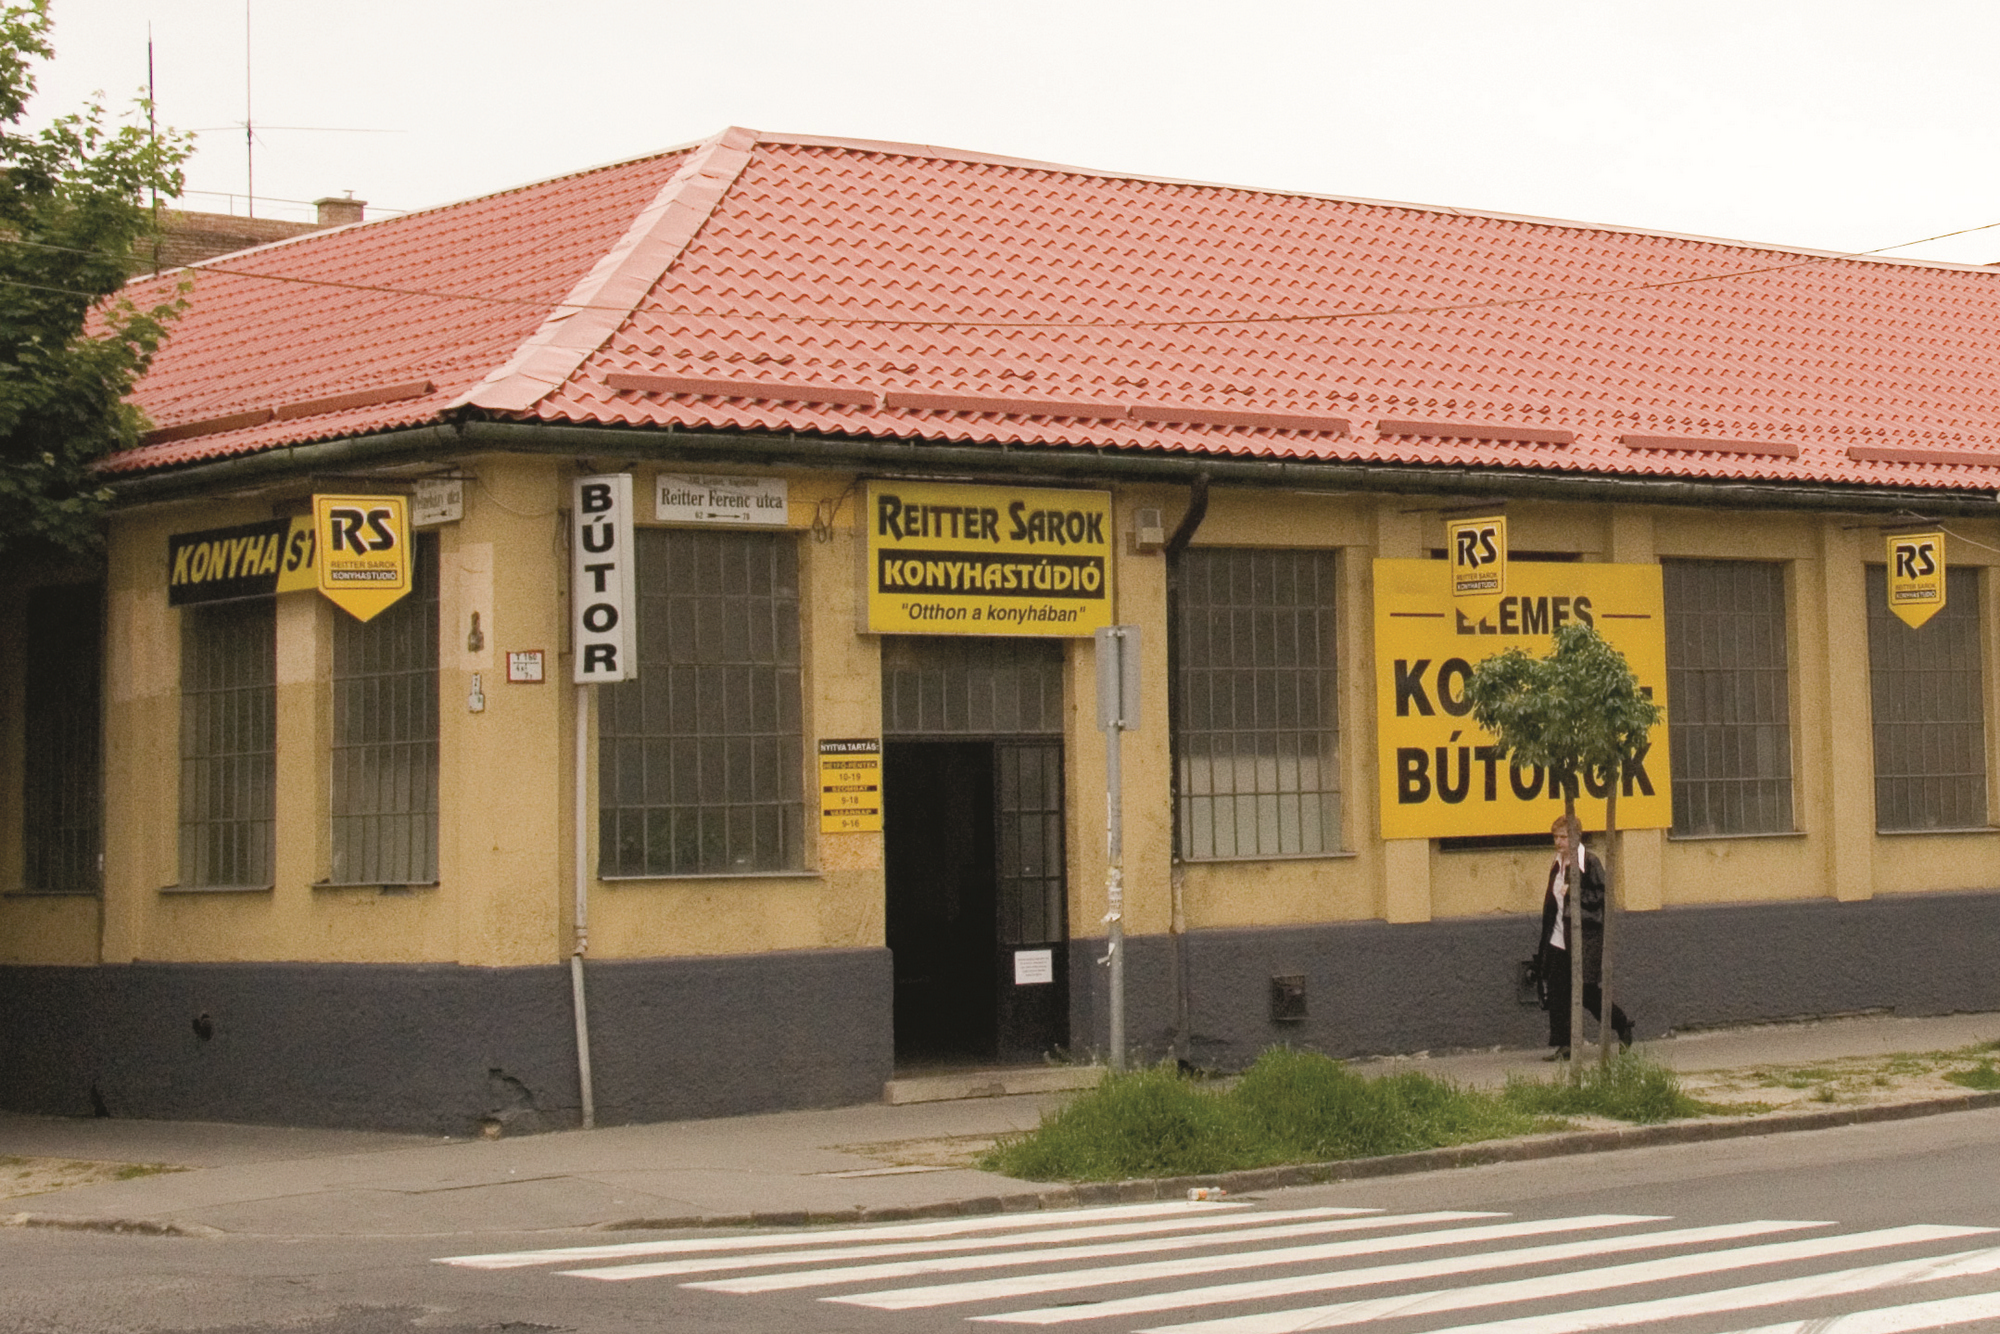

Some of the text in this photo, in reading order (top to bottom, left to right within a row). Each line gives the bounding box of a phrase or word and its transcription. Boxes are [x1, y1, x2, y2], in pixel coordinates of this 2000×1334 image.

[661, 488, 783, 509] Reitter Ferenc utca
[329, 506, 397, 557] RS
[878, 495, 1000, 544] REITTER
[1457, 526, 1499, 570] RS
[1896, 542, 1937, 581] RS
[331, 561, 397, 569] REITTER SAROK
[581, 483, 619, 674] BÚTOR
[884, 559, 1101, 592] KONYHASTÚDIÓ
[902, 603, 1086, 625] "Otthon a konyhában"
[820, 743, 847, 752] NYITVA
[839, 773, 862, 781] 10-19
[842, 819, 860, 828] 9-16
